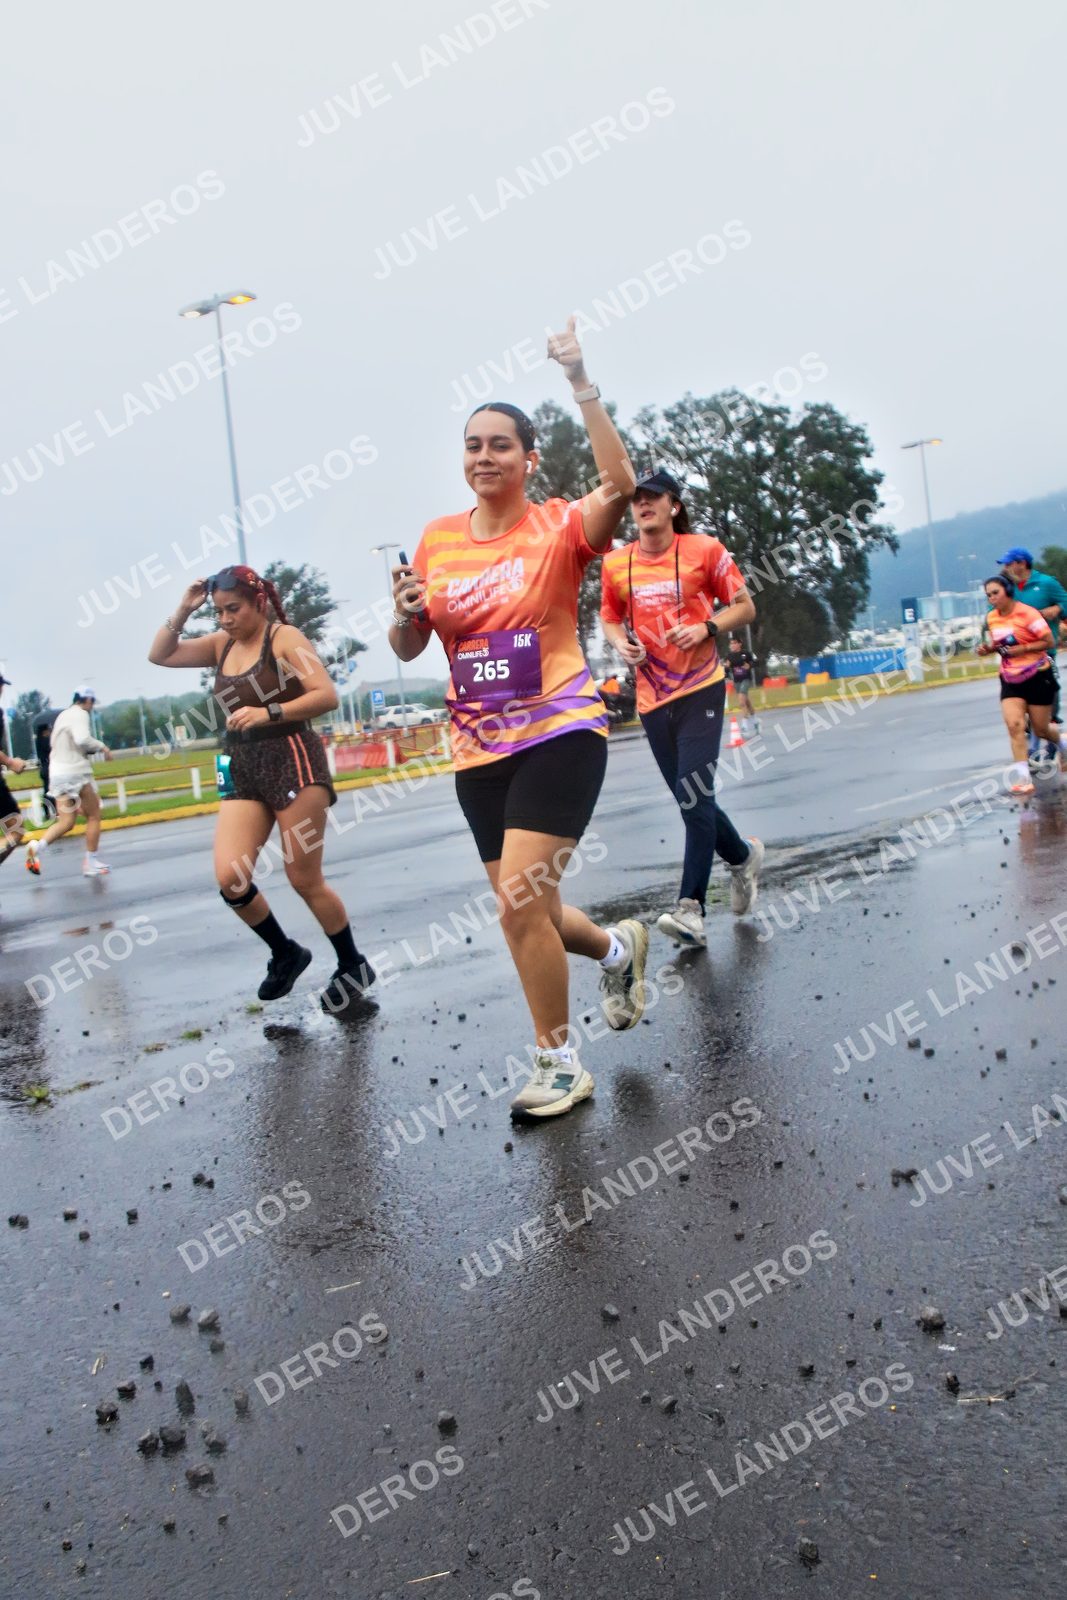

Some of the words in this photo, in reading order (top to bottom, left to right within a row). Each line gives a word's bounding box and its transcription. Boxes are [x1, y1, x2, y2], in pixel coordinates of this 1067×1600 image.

[447, 556, 524, 598] CARRERA
[904, 608, 915, 622] E
[458, 638, 489, 653] CARRERA
[513, 633, 532, 648] 15K
[472, 659, 510, 682] 265
